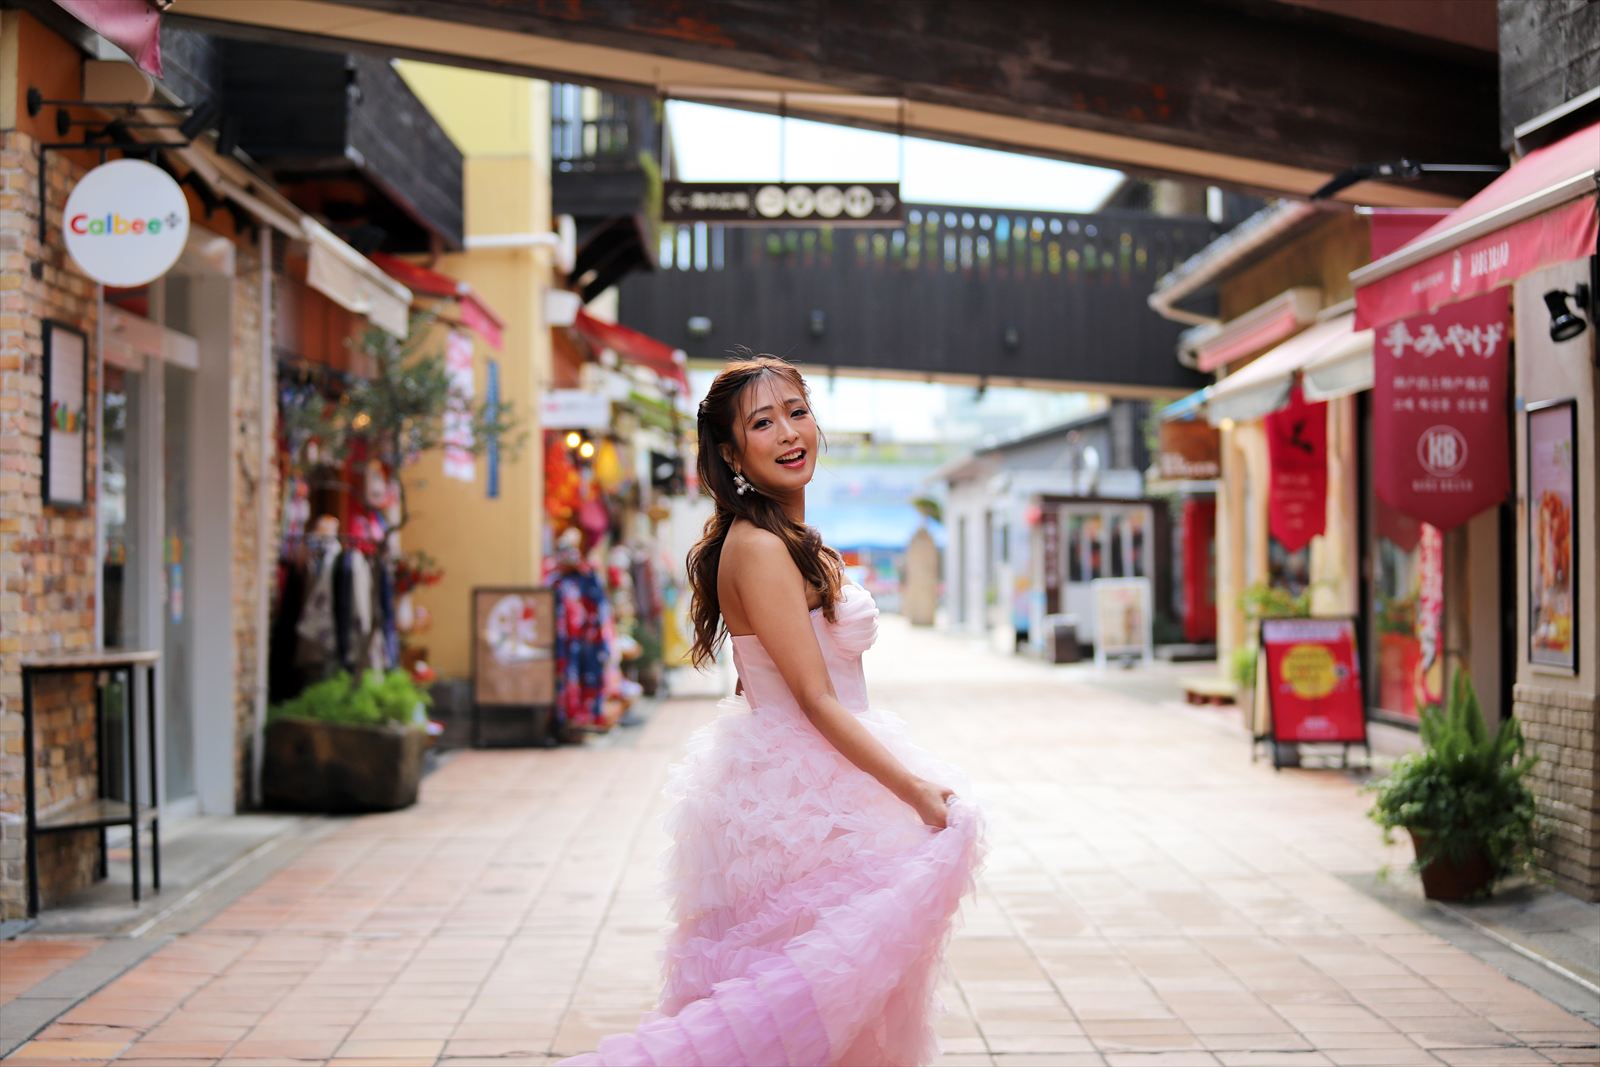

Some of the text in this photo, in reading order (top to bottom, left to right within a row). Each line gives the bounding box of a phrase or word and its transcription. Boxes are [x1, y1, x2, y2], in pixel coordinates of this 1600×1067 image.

[1382, 320, 1503, 358] 手みやげ
[1428, 431, 1457, 468] KB
